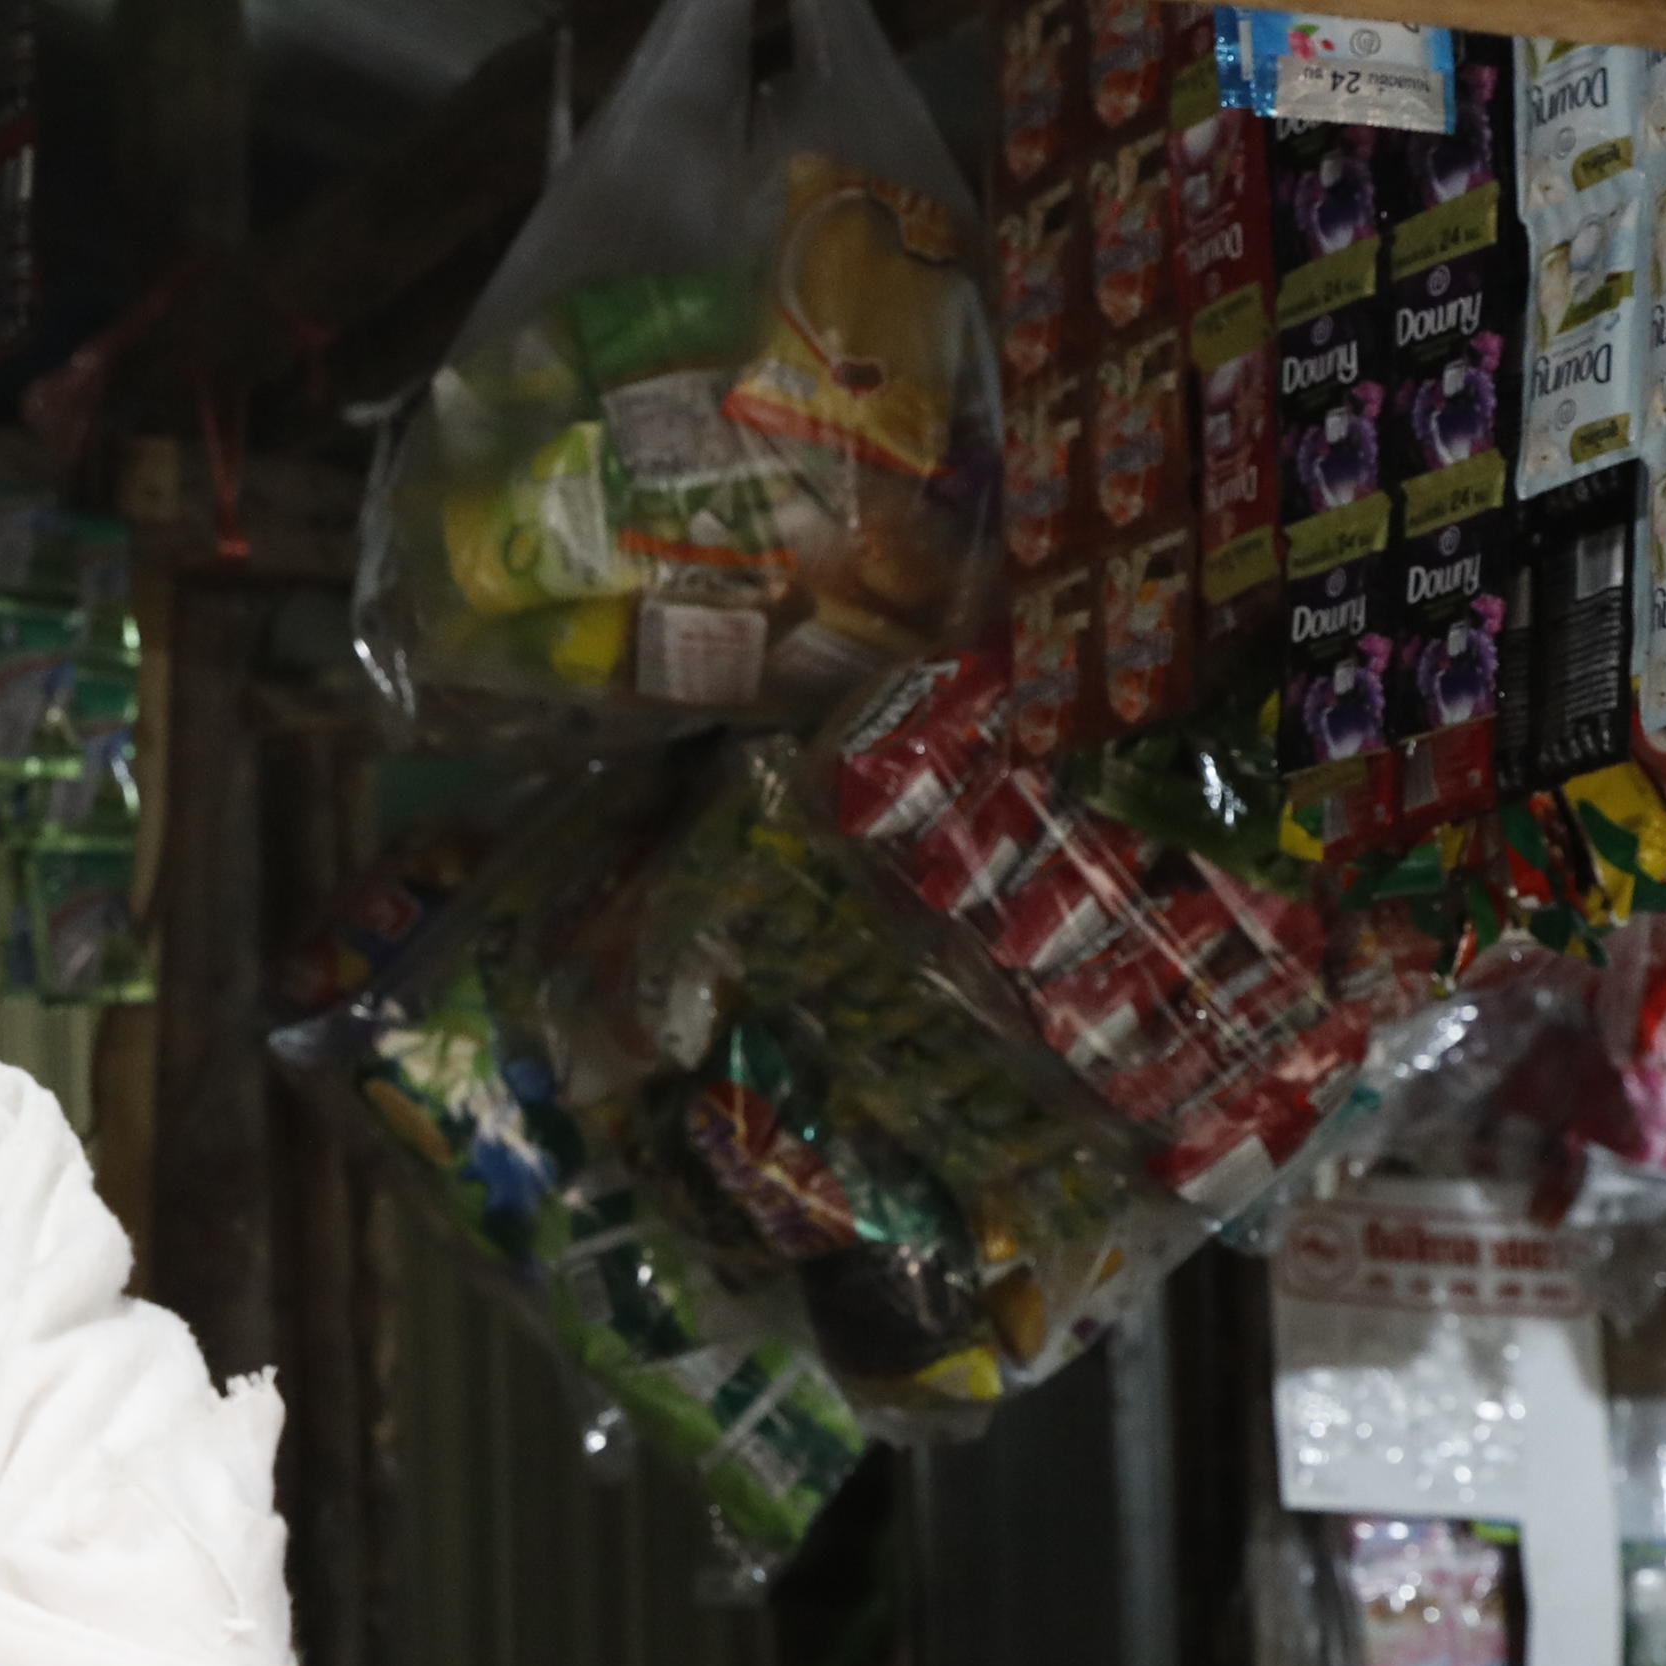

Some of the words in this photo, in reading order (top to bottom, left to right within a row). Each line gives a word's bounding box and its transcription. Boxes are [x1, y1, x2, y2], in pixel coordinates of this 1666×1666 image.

[1330, 71, 1360, 93] 24
[1529, 67, 1608, 126] Downy
[1396, 291, 1484, 347] Downy
[1282, 341, 1359, 395] Downy
[1533, 343, 1612, 397] Downy
[1406, 553, 1482, 604] Downy
[1290, 594, 1367, 643] Downy
